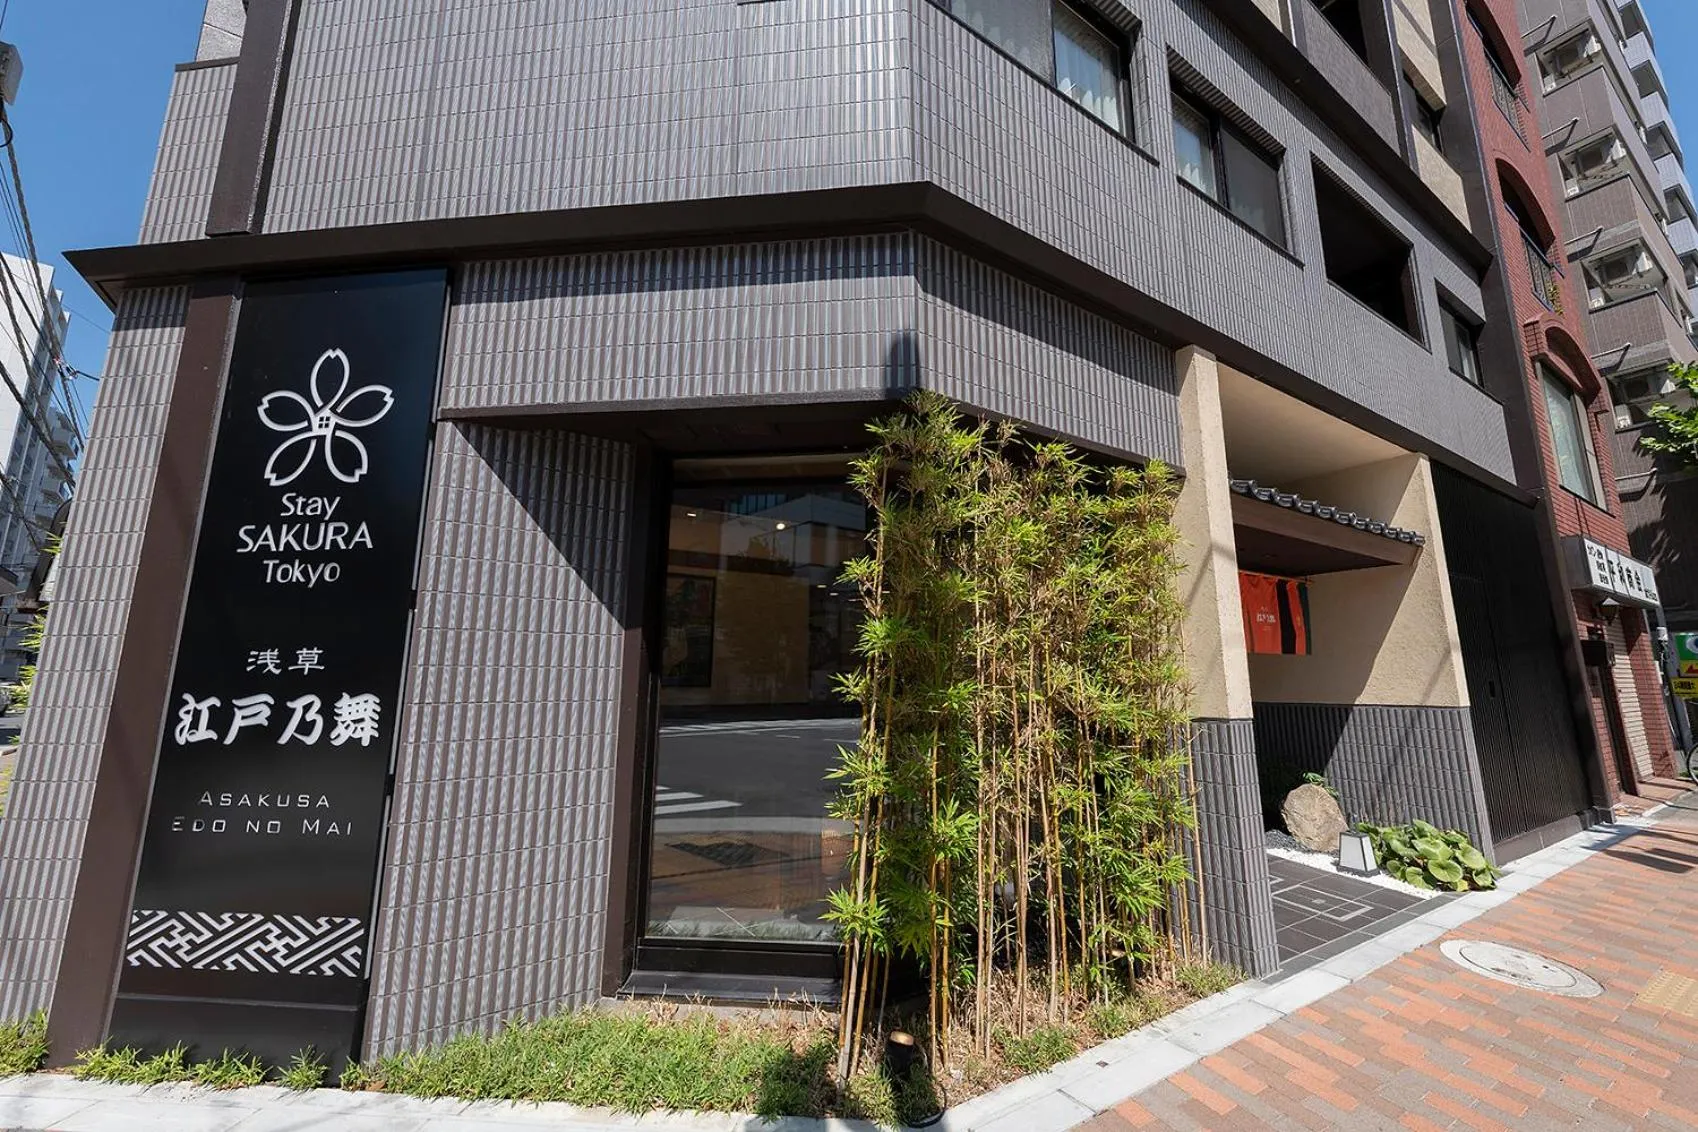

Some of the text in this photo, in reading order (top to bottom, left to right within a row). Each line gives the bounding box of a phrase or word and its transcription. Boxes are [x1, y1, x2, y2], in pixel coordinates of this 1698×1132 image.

[281, 492, 342, 521] Stay
[236, 521, 374, 553] SAKURA
[263, 558, 341, 588] Tokyo
[246, 646, 326, 675] 浅草
[174, 692, 381, 748] 江戸乃舞
[200, 790, 330, 809] ASAKUSA
[171, 816, 352, 836] EDO NO MAI
